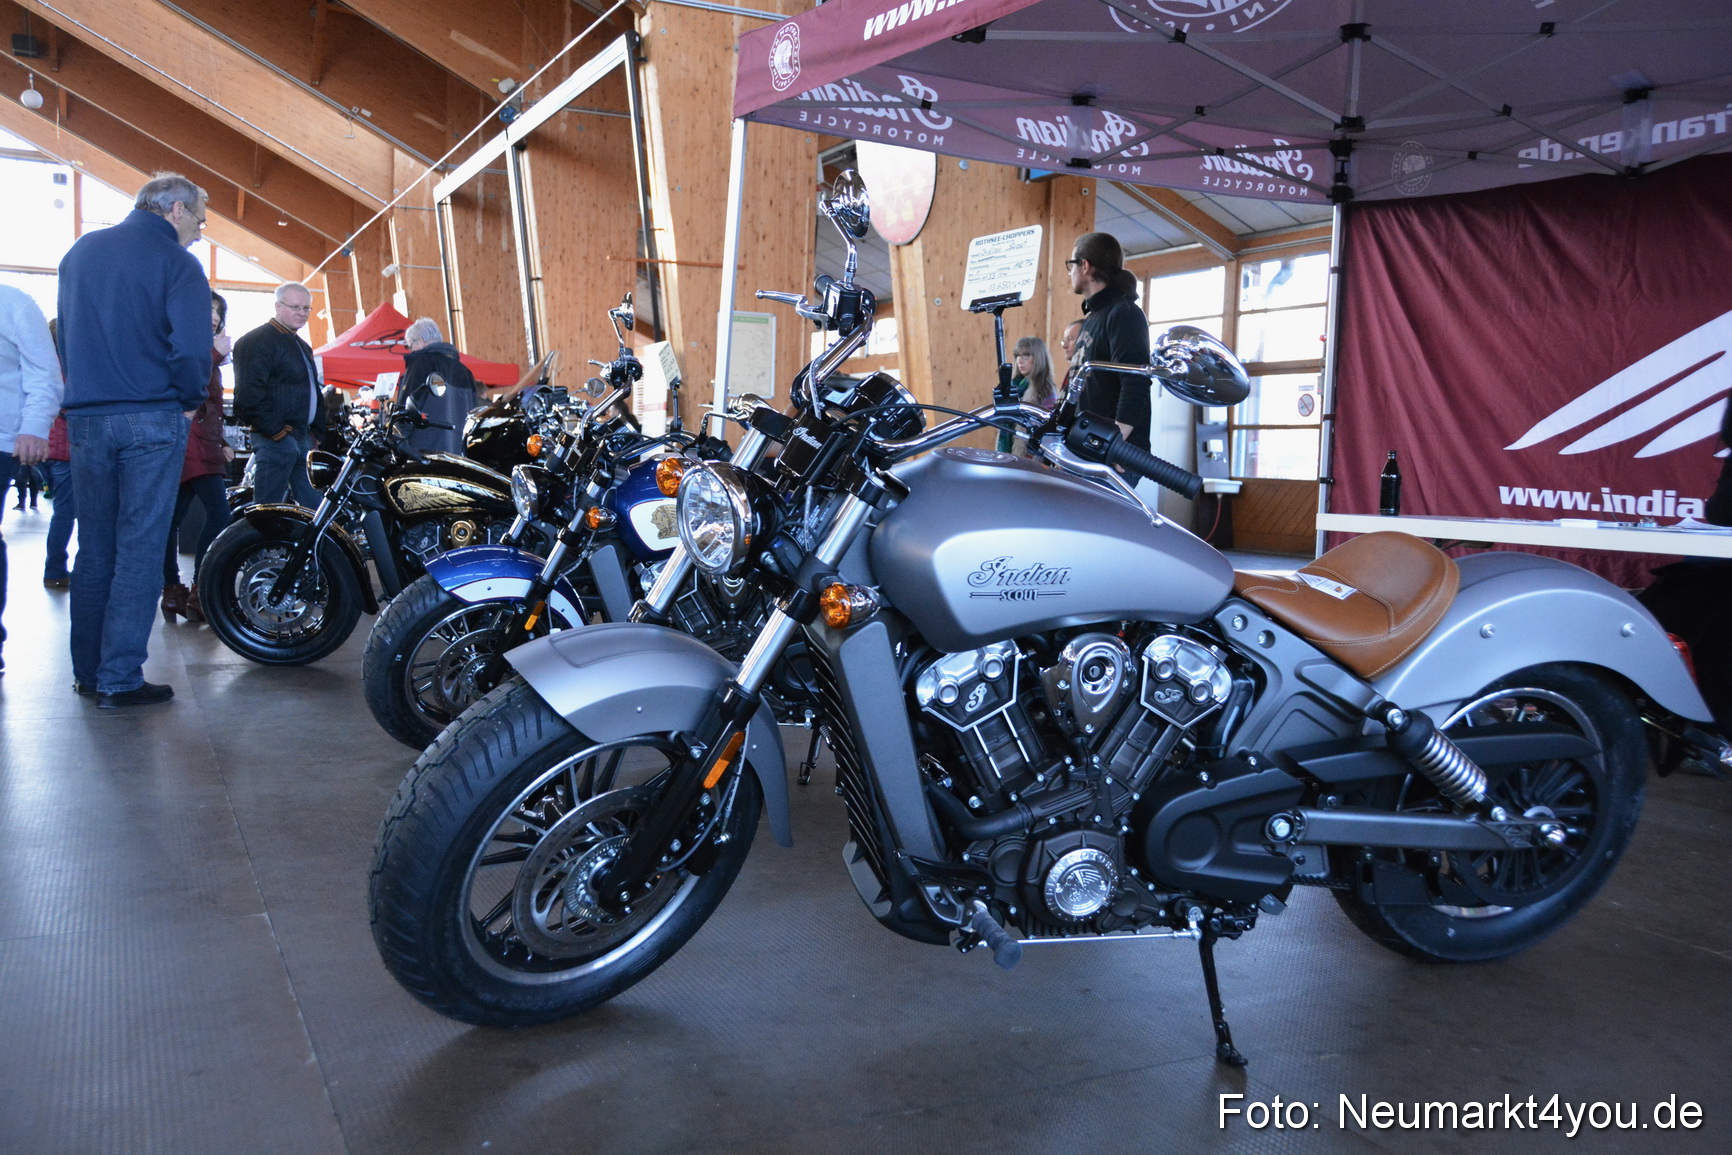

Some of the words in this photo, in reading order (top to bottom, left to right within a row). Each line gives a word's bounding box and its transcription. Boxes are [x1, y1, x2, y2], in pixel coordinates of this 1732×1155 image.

[863, 0, 965, 41] www.
[975, 228, 1035, 246] ROTHSEE-CHOPPERS
[792, 426, 823, 450] Indian
[1498, 485, 1709, 520] www.india
[967, 555, 1072, 588] Indian
[1000, 588, 1039, 602] SCOUT
